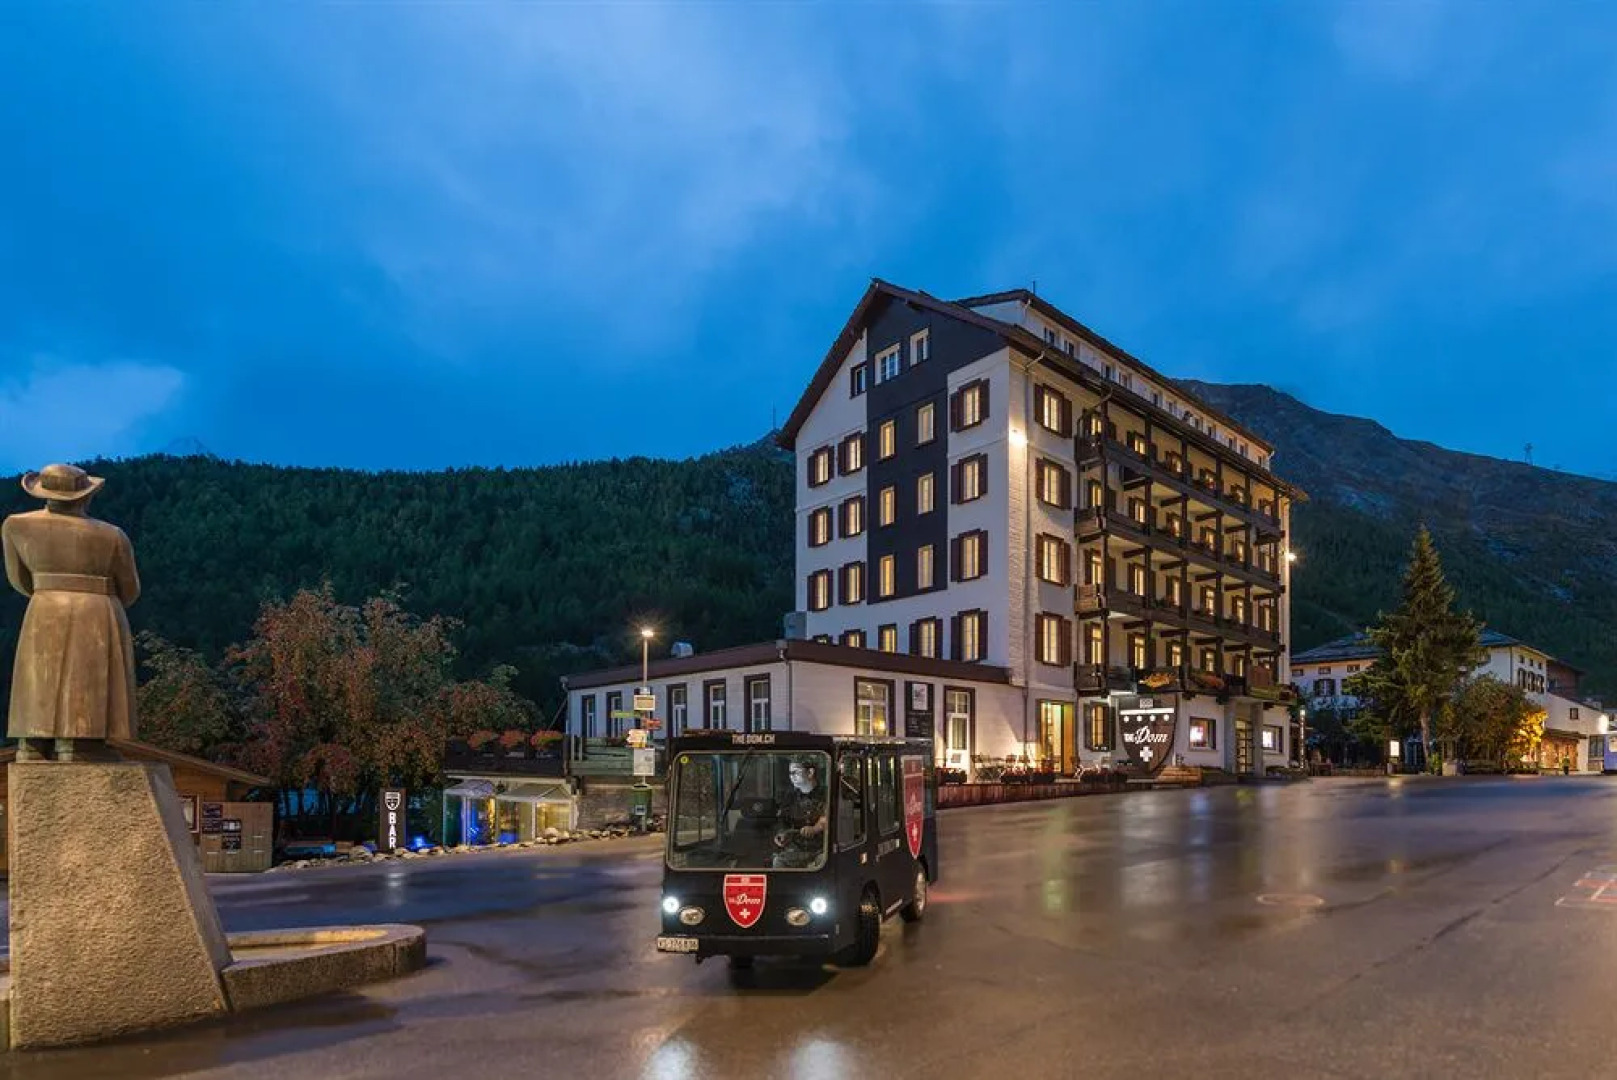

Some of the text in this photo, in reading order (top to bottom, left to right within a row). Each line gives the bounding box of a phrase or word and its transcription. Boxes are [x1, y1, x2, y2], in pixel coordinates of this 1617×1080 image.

[1134, 725, 1168, 745] Dom
[388, 811, 397, 849] BAR
[736, 893, 761, 905] Dom
